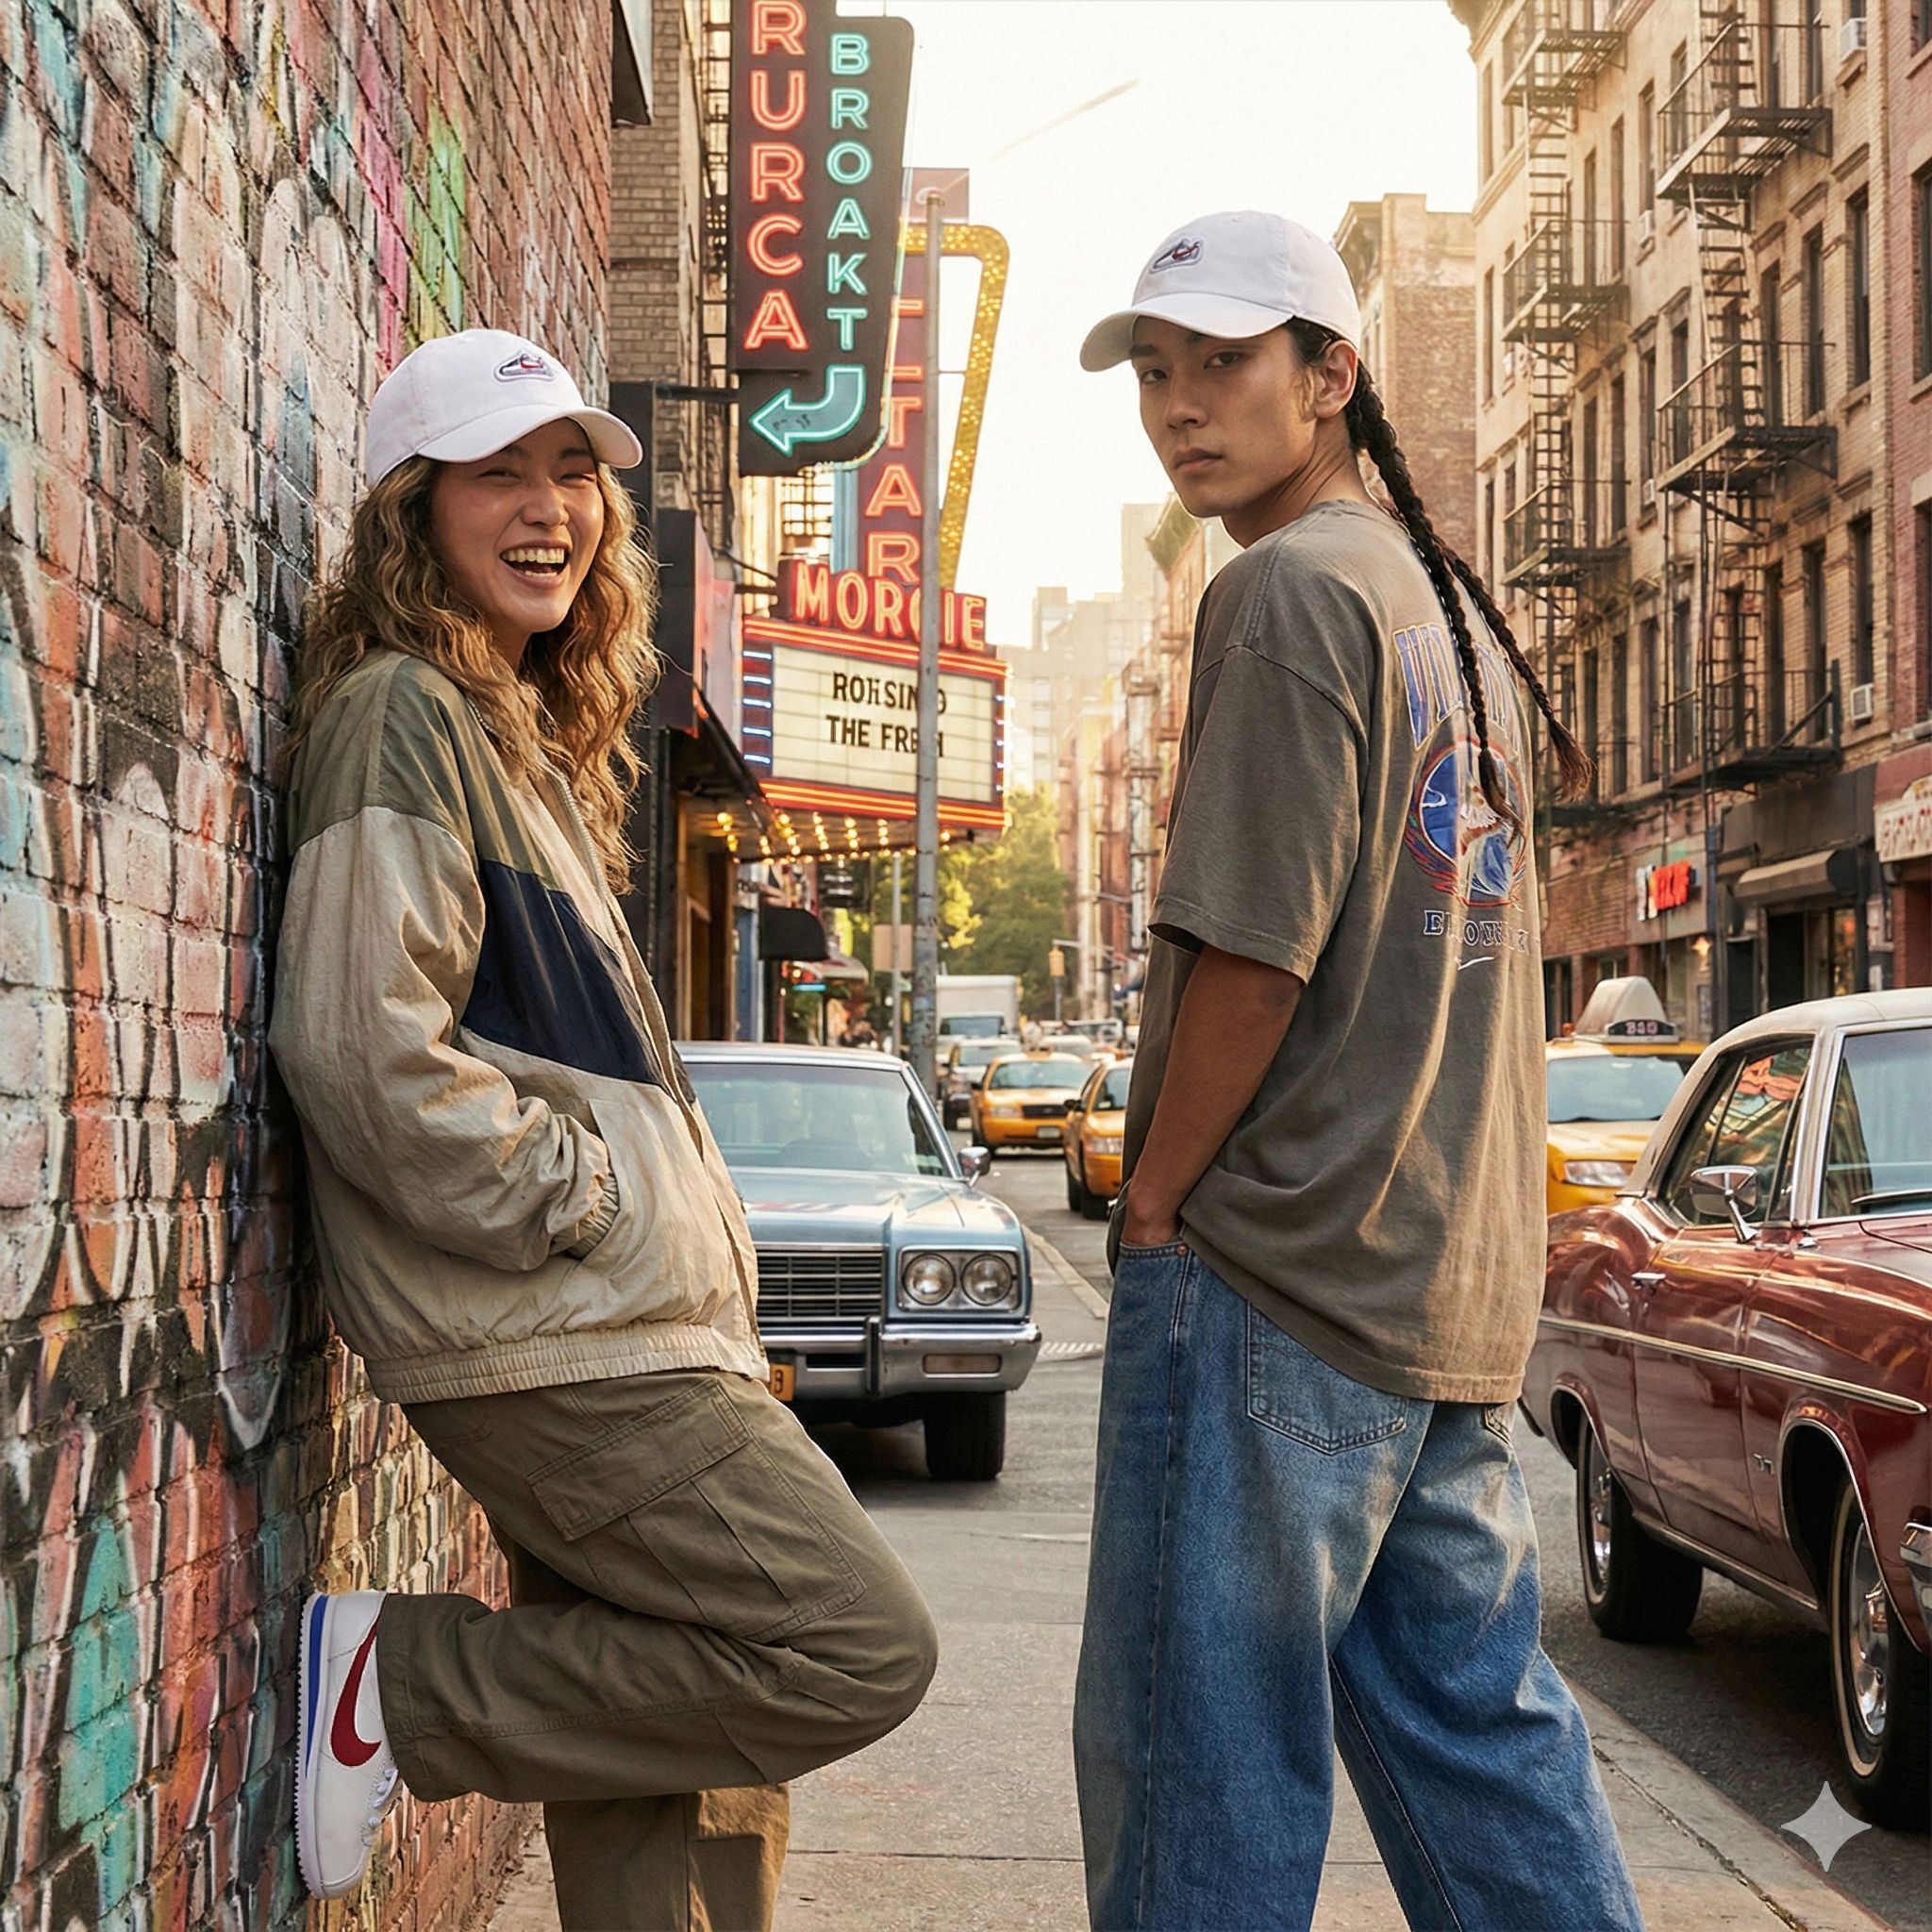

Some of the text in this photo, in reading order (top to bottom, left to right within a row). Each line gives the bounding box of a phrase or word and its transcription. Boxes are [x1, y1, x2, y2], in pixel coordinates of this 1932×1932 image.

[744, 0, 808, 352] RURCA
[825, 32, 874, 351] BROAKT
[825, 714, 871, 748] THE
